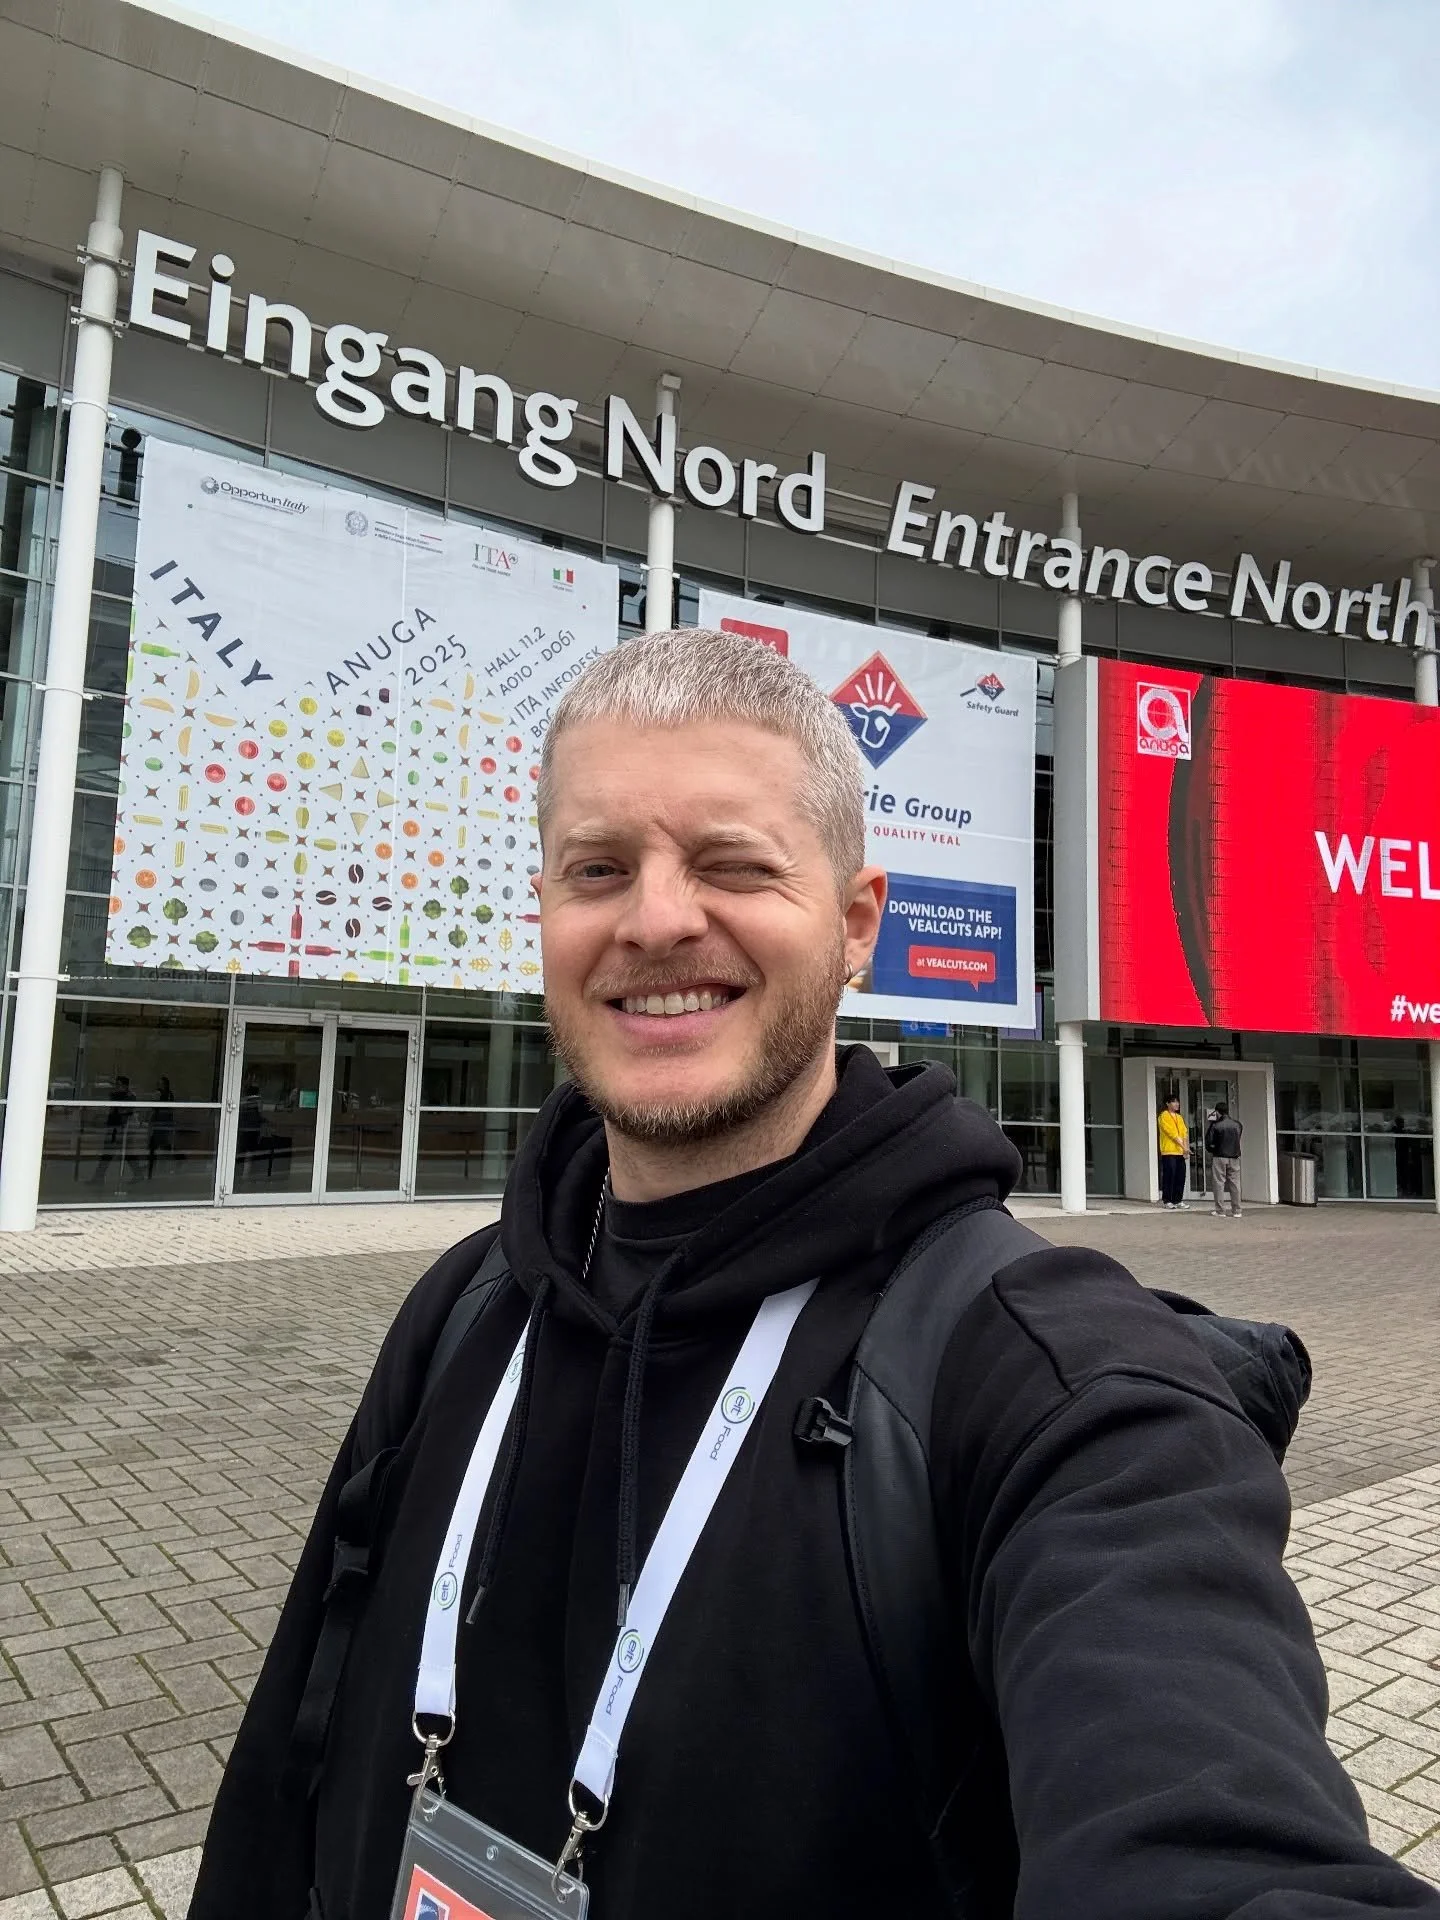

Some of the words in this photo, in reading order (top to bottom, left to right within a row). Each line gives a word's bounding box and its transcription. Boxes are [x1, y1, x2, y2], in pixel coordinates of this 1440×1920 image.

[129, 229, 579, 489] Eingang
[605, 394, 826, 533] Nord
[886, 480, 1213, 612] Entrance
[1230, 552, 1429, 647] North
[474, 543, 511, 570] ITA
[149, 560, 274, 687] ITALY
[326, 607, 436, 695] ANUGA
[404, 634, 467, 685] 2025
[484, 648, 520, 677] HALL
[519, 626, 546, 648] 11.2
[514, 695, 542, 720] ITA
[966, 701, 992, 714] Safety
[994, 705, 1019, 717] Guard
[1140, 738, 1189, 756] anuga
[905, 797, 972, 829] Group
[873, 825, 926, 841] QUALITY
[931, 832, 961, 847] VEAL
[1314, 830, 1440, 900] WEL
[888, 900, 965, 921] DOWNLOAD
[968, 908, 993, 923] THE
[908, 917, 972, 937] VEALCUTS
[974, 924, 1003, 940] APP!
[916, 958, 925, 967] at
[926, 957, 988, 972] VEALCUTS.COM
[709, 1425, 731, 1461] Food
[448, 1534, 463, 1568] Food
[605, 1675, 624, 1716] Food
